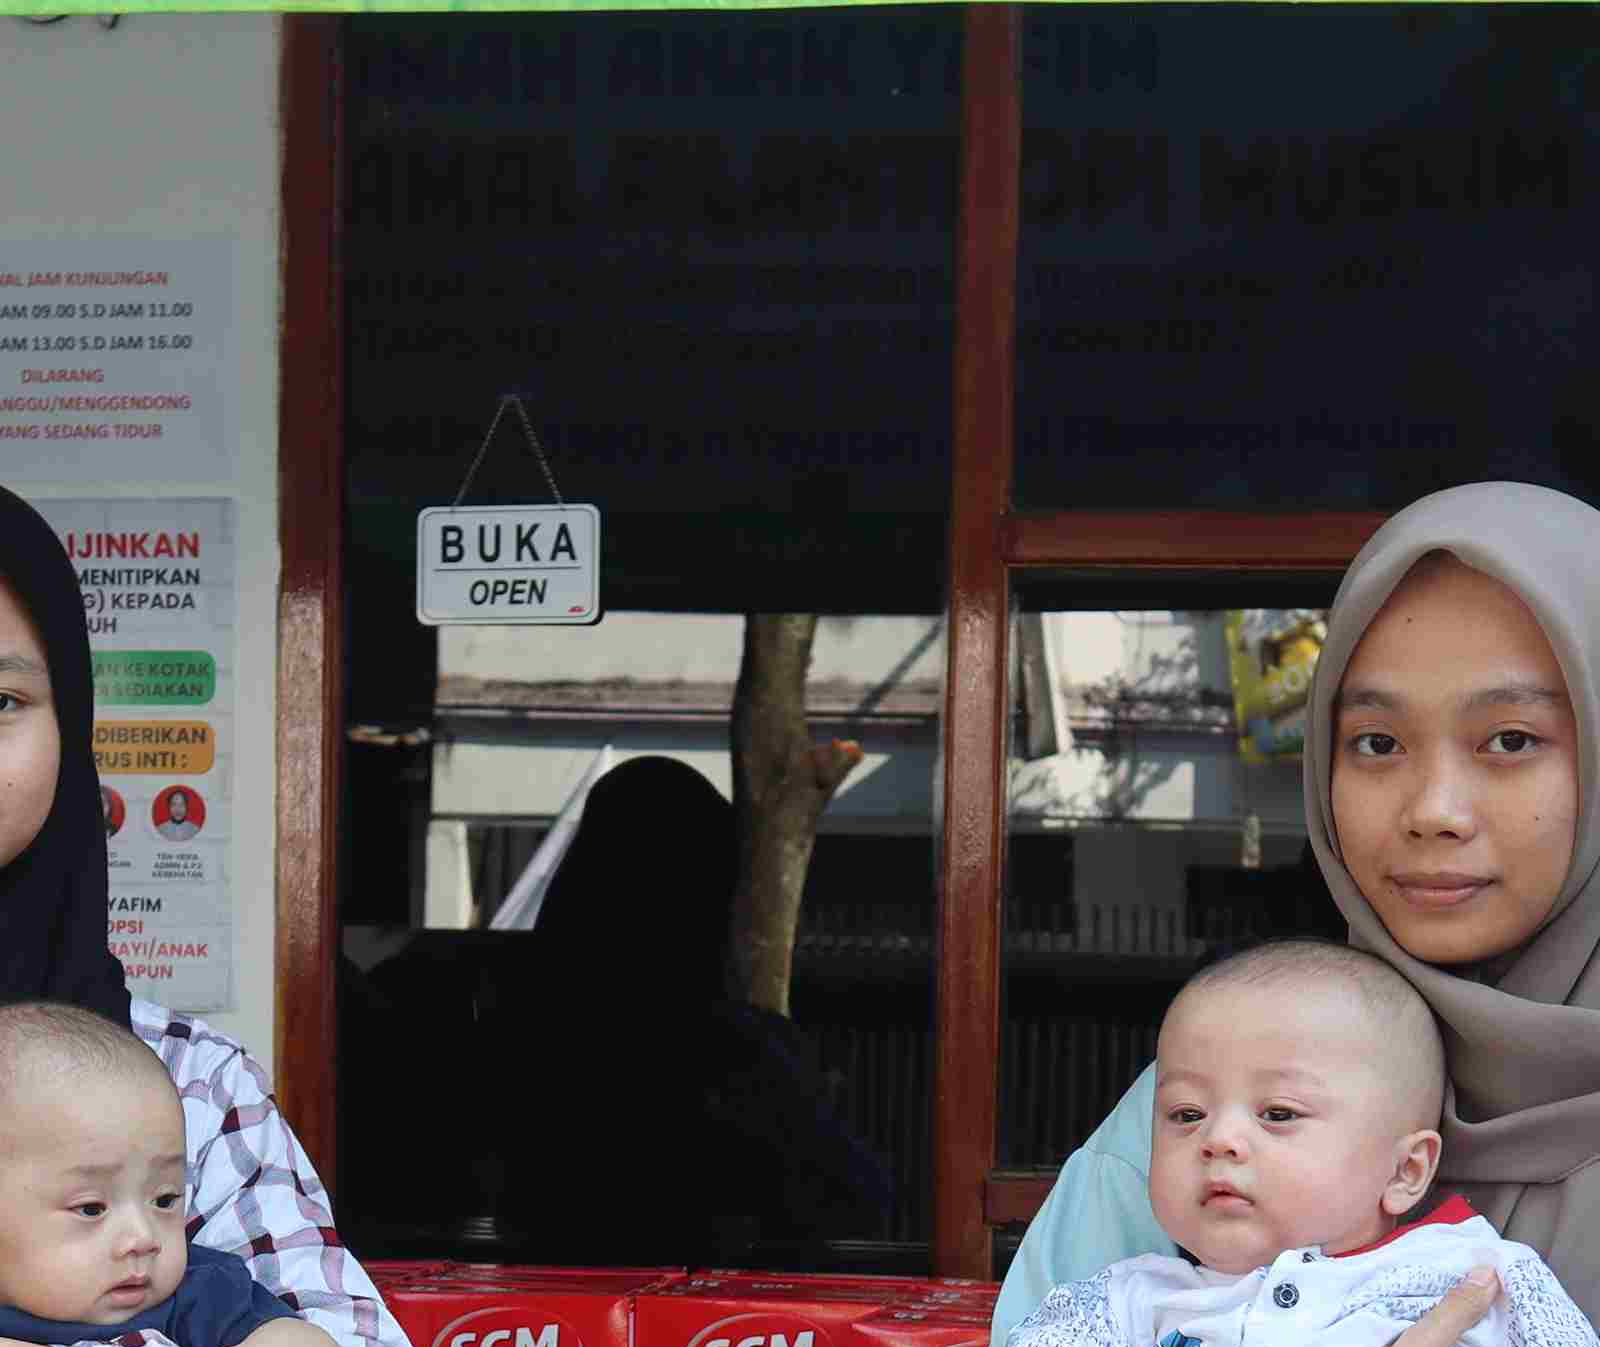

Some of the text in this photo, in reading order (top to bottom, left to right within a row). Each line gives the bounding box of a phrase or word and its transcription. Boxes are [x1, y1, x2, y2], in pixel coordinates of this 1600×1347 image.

[27, 272, 61, 287] JAM
[64, 271, 168, 287] KUNJUNGAN
[109, 303, 144, 318] JAM
[149, 302, 193, 317] 11.00
[32, 336, 76, 351] 13.00
[110, 335, 144, 350] JAM
[21, 368, 104, 384] DILARANG
[45, 424, 109, 440] SEDANG
[112, 423, 163, 439] TIDUR
[67, 532, 200, 559] IJINKAN
[441, 522, 577, 563] BUKA
[469, 578, 547, 605] OPEN
[112, 592, 196, 609] KEPADA
[88, 617, 117, 633] UH
[148, 663, 210, 677] KOTAK
[95, 727, 208, 745] DIBERIKAN
[95, 752, 130, 768] RUS
[137, 751, 176, 768] INTI
[125, 964, 174, 979] APUN
